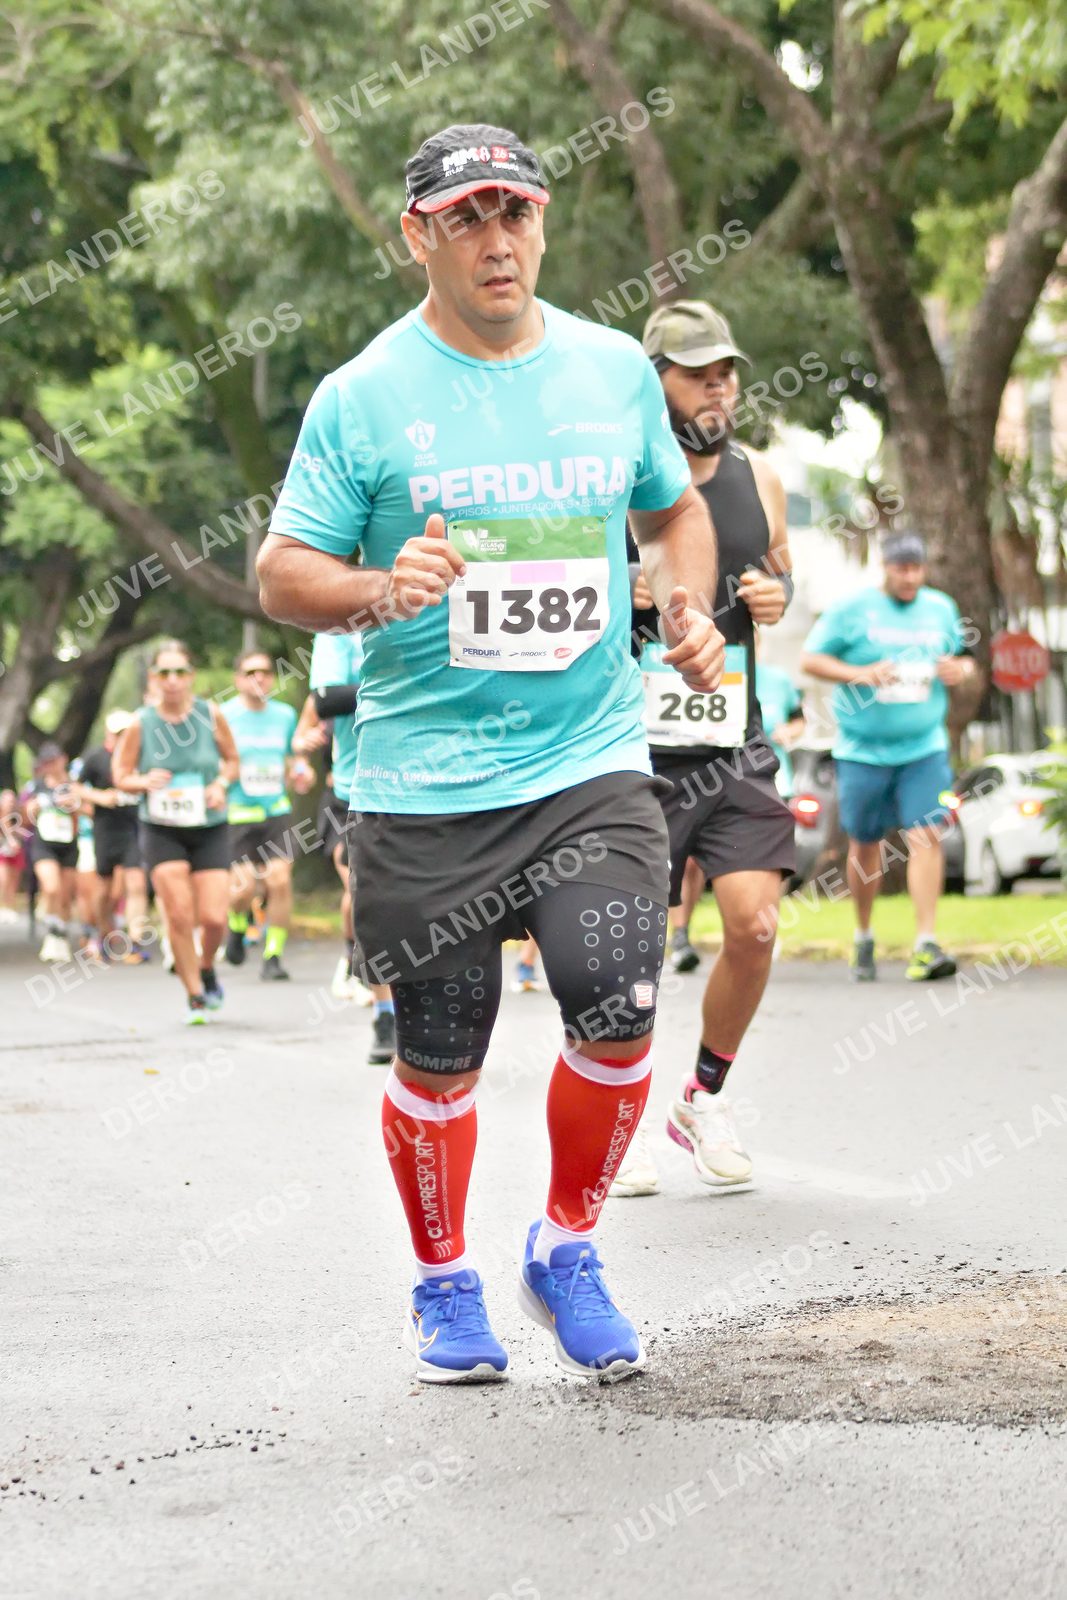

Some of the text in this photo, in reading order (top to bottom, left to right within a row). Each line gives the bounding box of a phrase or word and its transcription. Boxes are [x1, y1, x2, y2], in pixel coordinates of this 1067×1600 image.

[575, 422, 624, 435] BROOKS
[409, 455, 627, 514] PERDURA
[458, 506, 490, 518] PISOS
[497, 500, 575, 513] JUNTEADORES
[466, 586, 601, 635] 1382
[462, 647, 501, 657] PERDURA
[659, 692, 727, 723] 268
[404, 1047, 473, 1071] COMPRE
